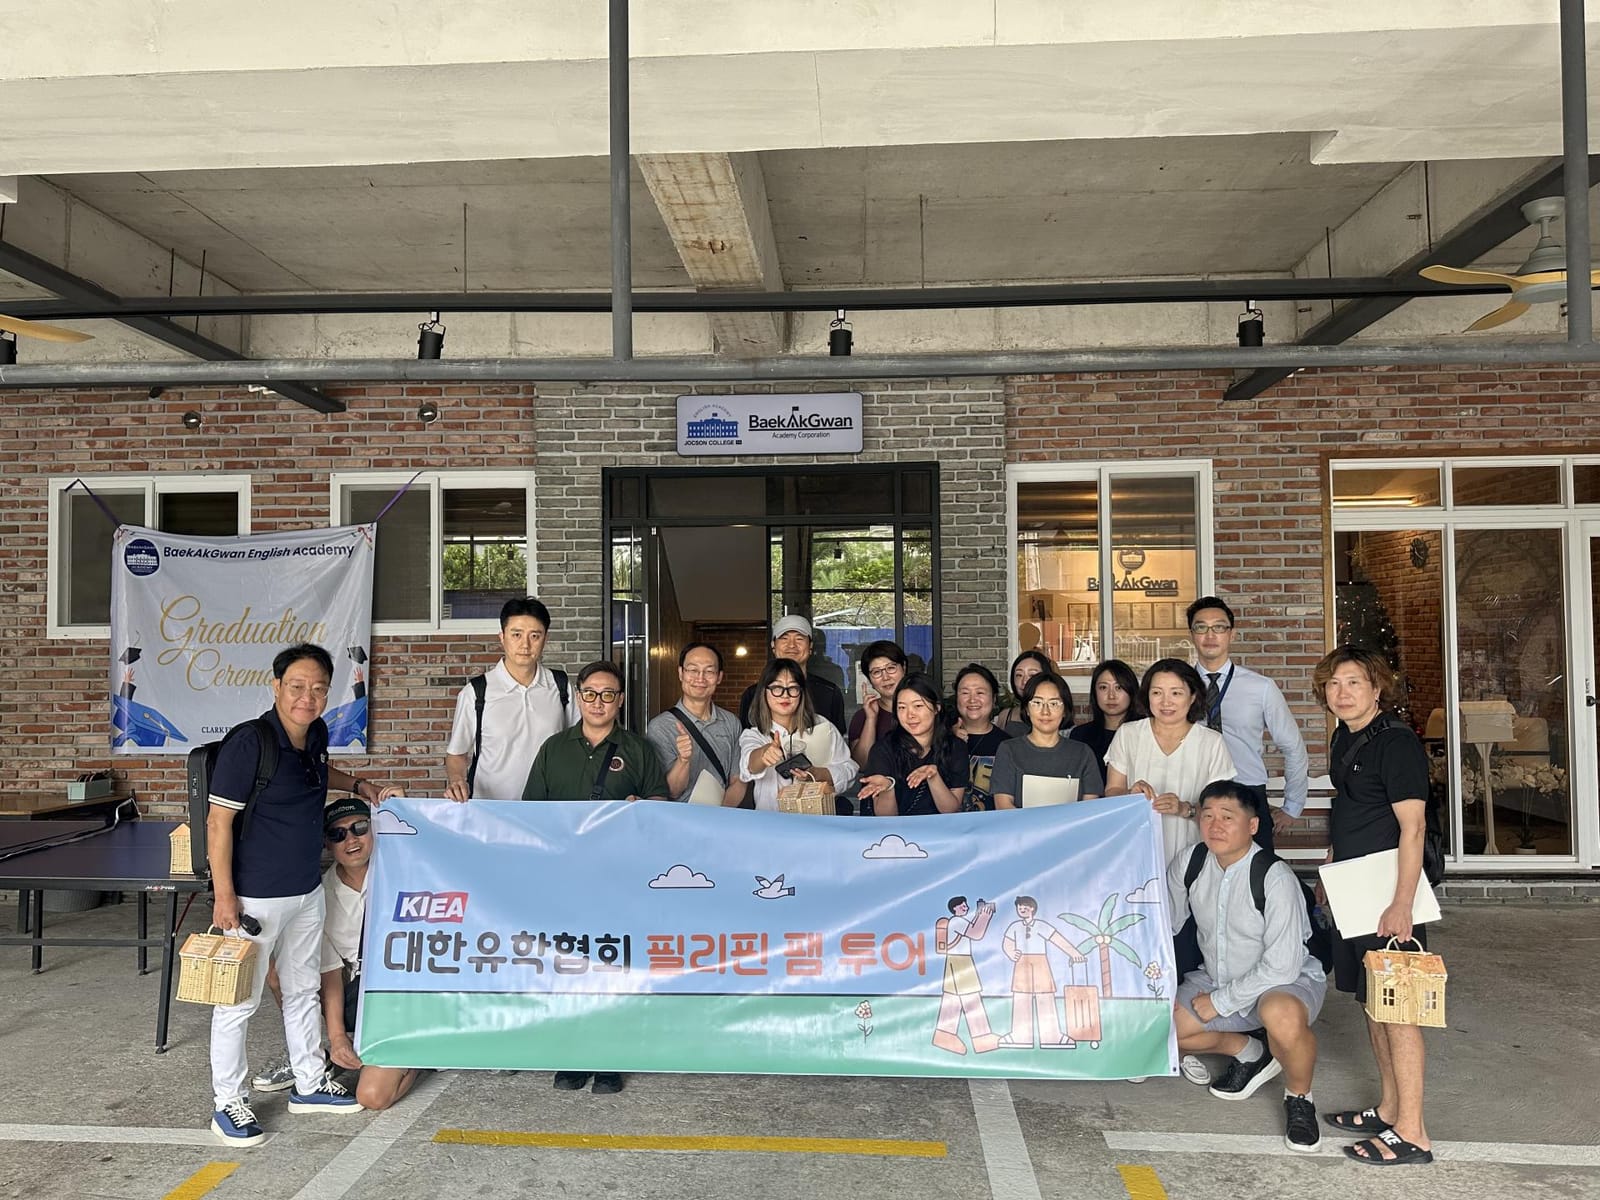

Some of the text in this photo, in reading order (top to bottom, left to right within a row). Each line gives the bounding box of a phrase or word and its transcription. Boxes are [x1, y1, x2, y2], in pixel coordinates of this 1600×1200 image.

[749, 412, 853, 429] BaekAkGwan
[772, 431, 831, 440] Academy Corporation
[163, 543, 356, 561] BaekAkGwan English Academy
[157, 595, 328, 666] Graduation
[186, 648, 274, 691] Ceremo
[201, 726, 225, 734] CLARK
[399, 896, 464, 919] KIEA
[383, 930, 927, 976] 대한유학협회 필리핀 팸 투어
